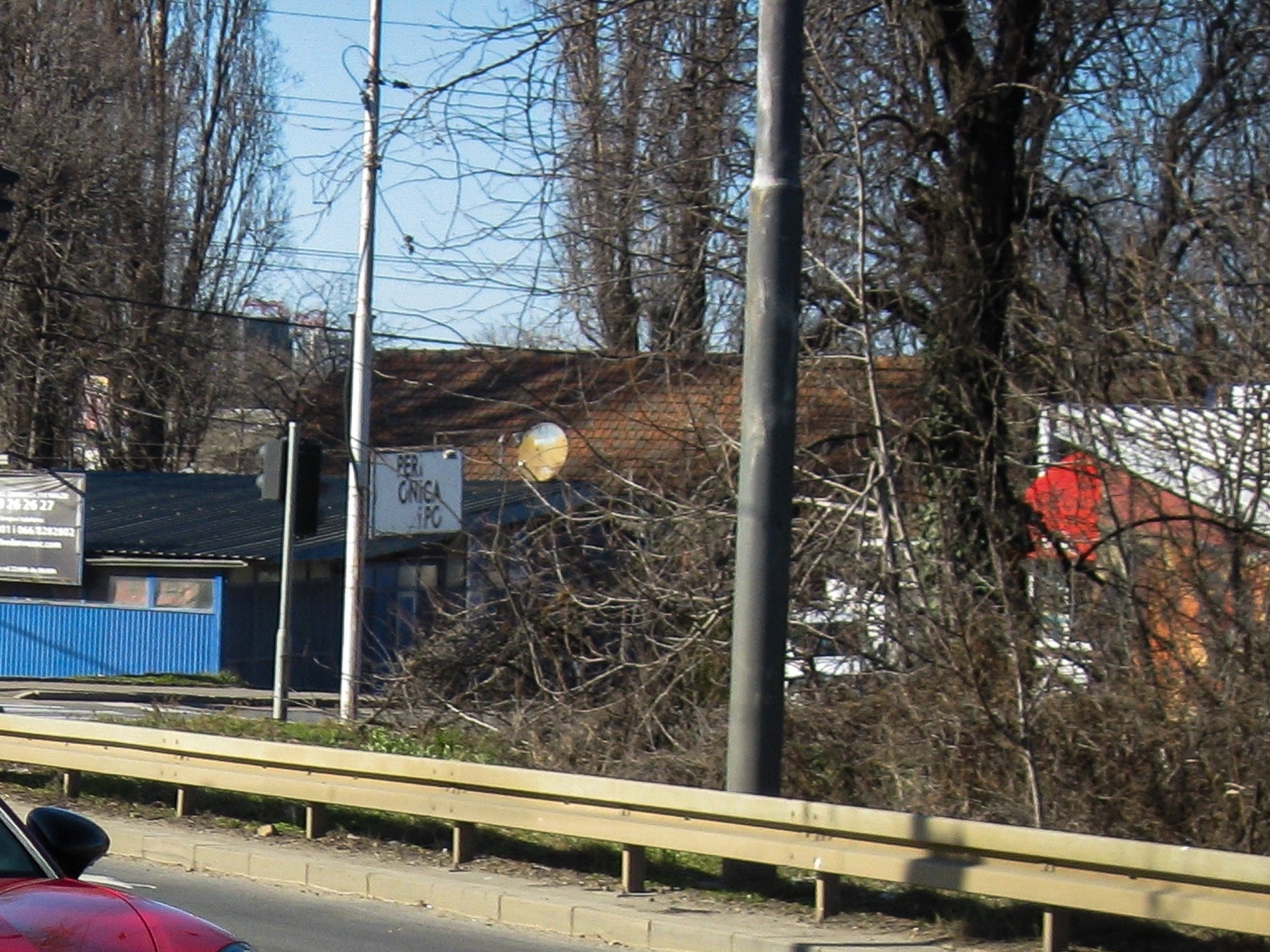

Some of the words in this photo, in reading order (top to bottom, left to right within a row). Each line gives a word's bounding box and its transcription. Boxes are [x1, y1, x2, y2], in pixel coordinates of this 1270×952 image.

[6, 498, 21, 511] 26
[22, 498, 38, 511] 26
[39, 499, 55, 511] 27
